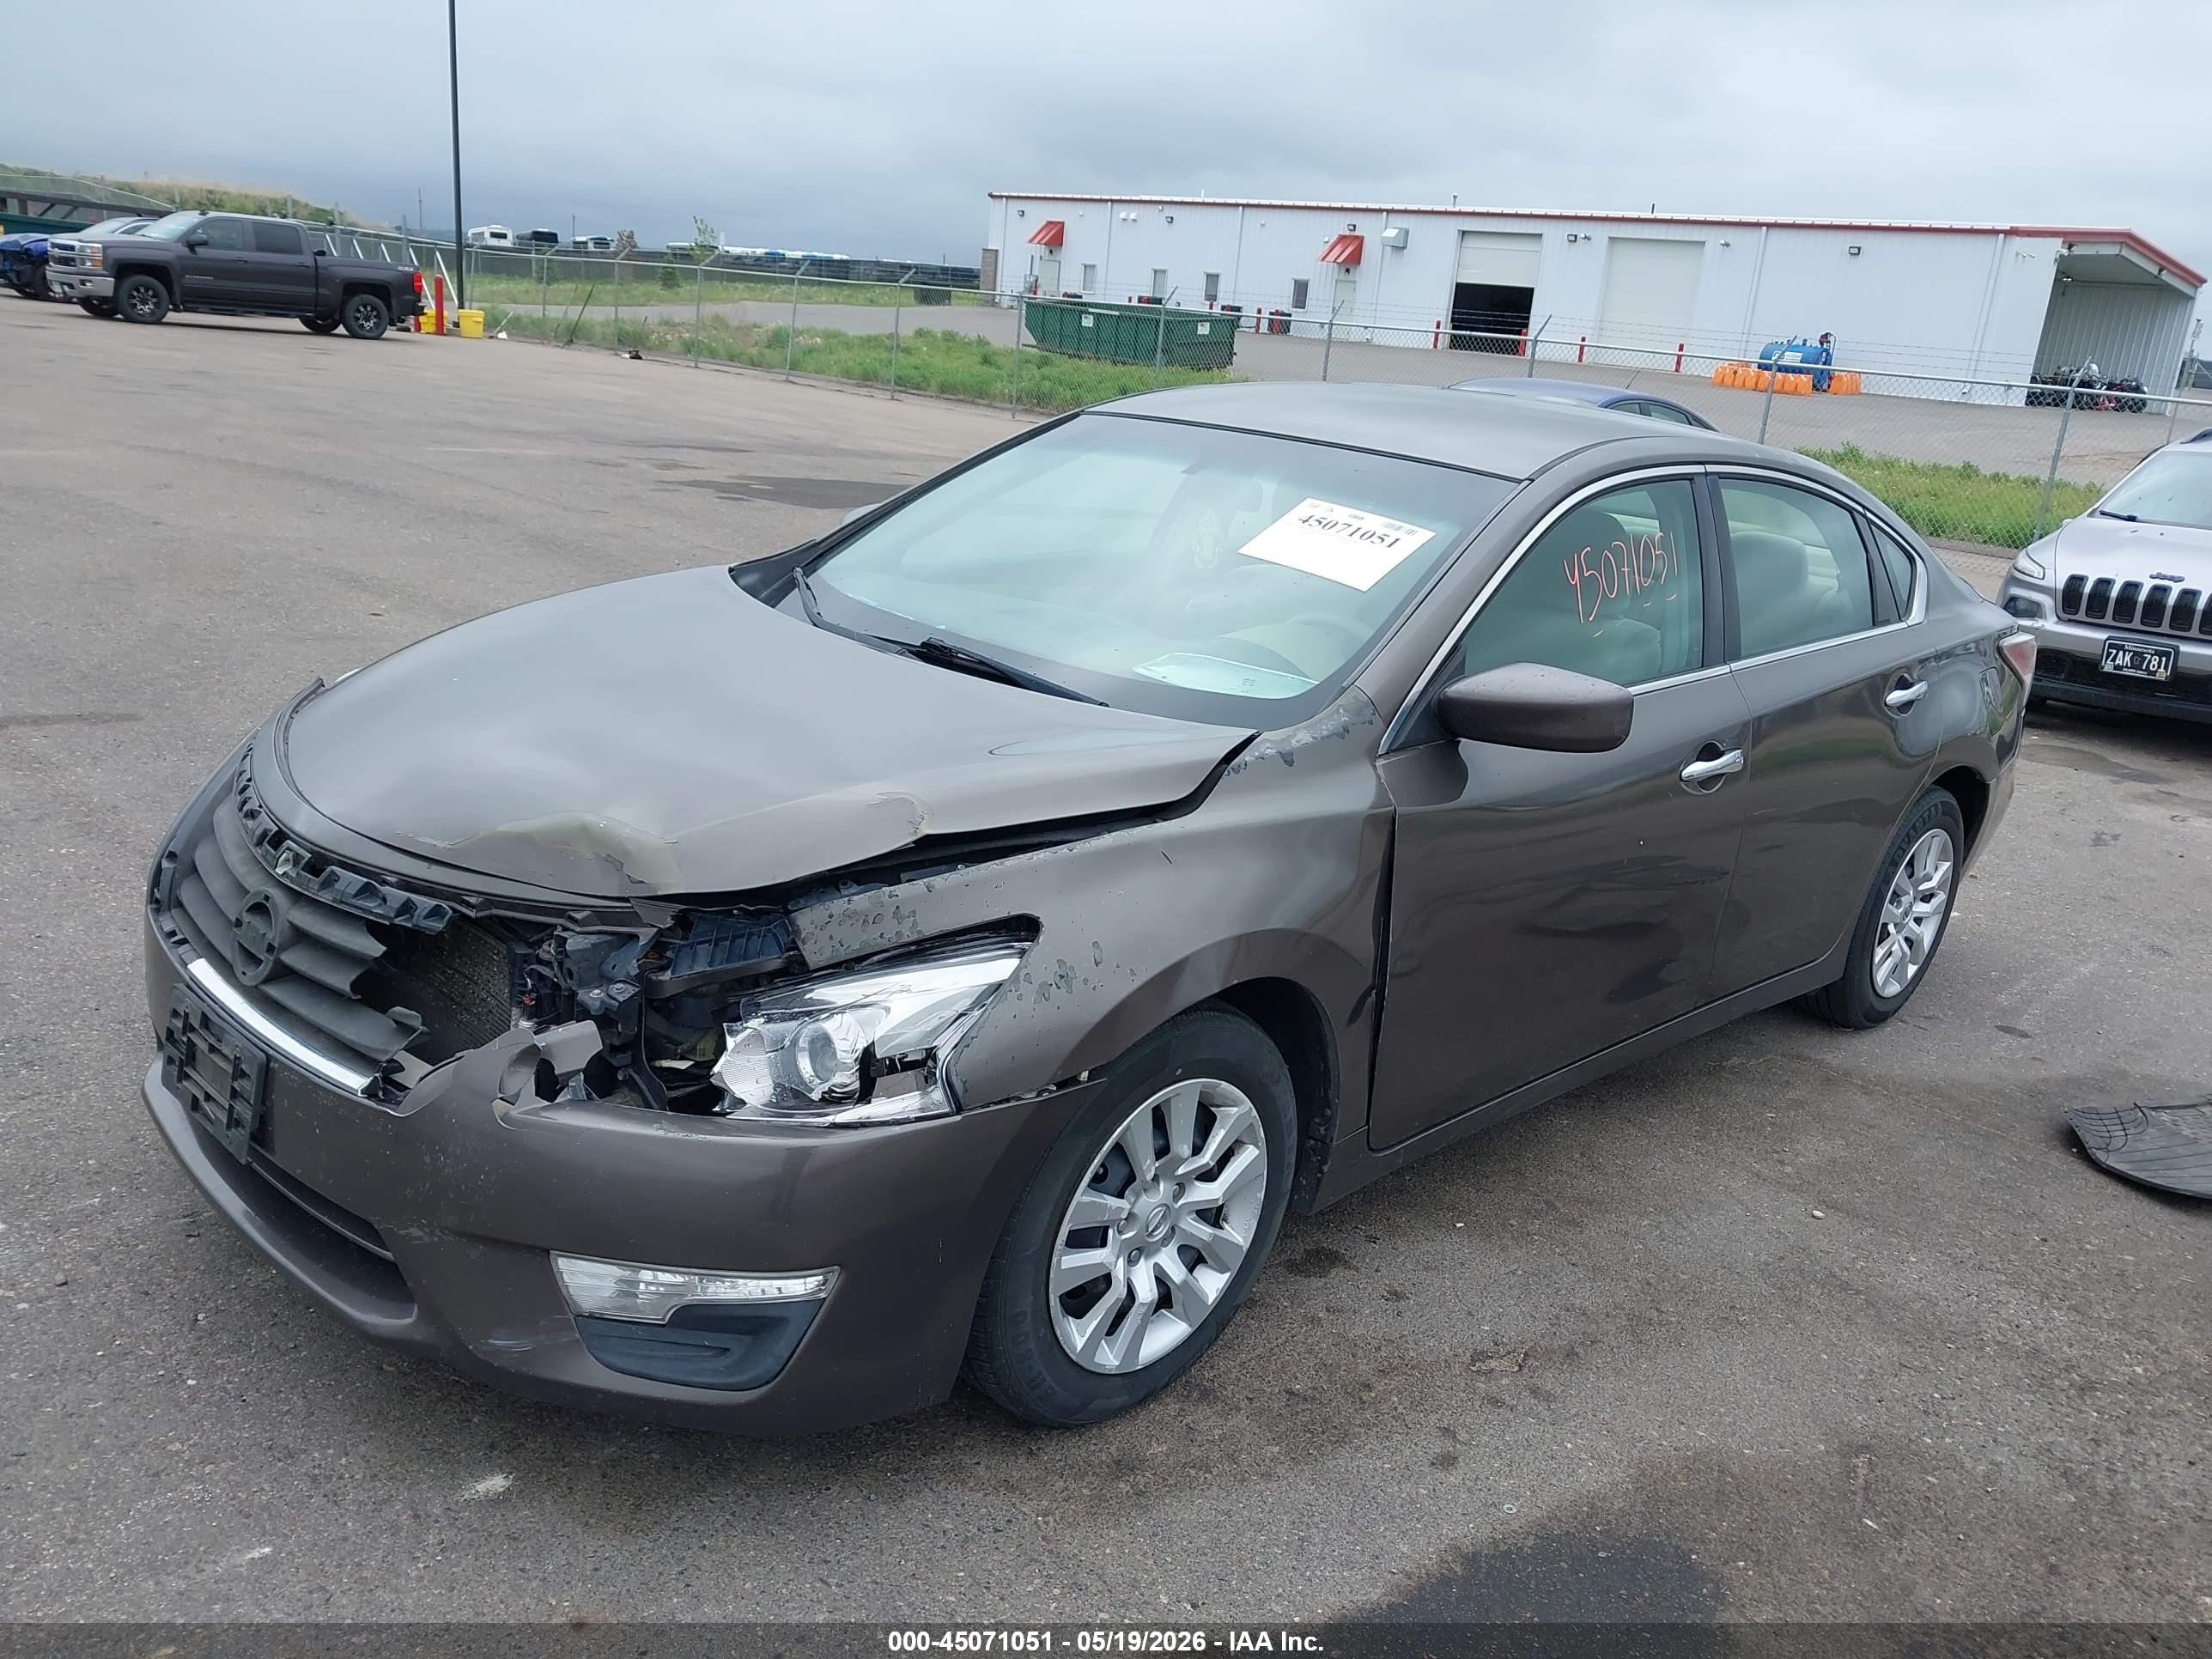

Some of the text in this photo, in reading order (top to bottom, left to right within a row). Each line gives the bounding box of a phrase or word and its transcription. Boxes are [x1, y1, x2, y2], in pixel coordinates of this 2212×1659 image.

[1298, 514, 1401, 548] 45071051
[1563, 531, 1679, 624] 45071051
[2106, 648, 2134, 667] ZAK
[2142, 654, 2166, 672] 781
